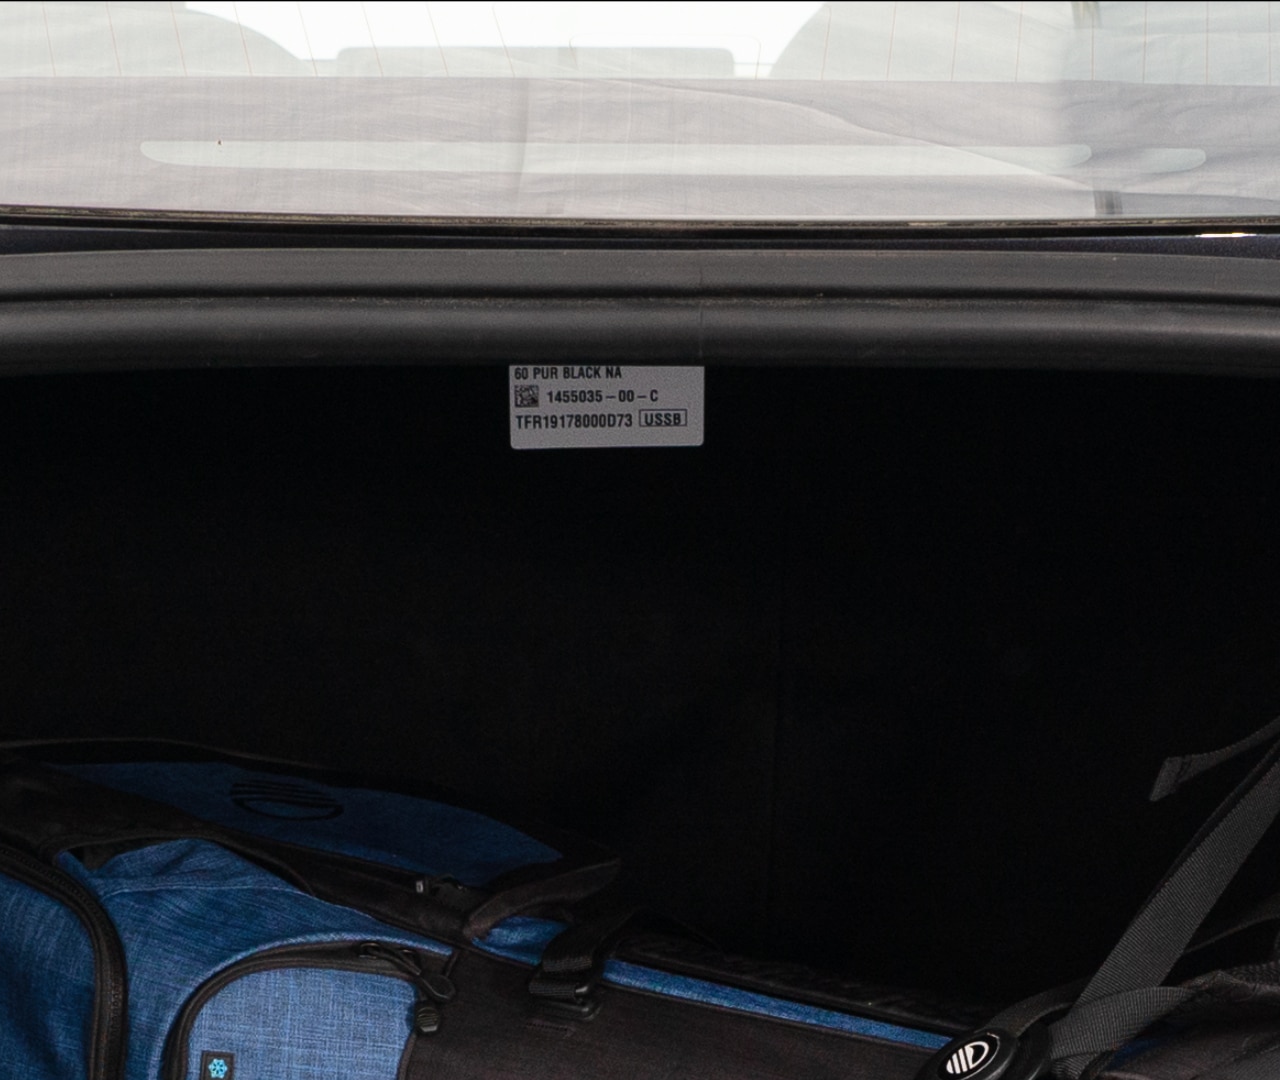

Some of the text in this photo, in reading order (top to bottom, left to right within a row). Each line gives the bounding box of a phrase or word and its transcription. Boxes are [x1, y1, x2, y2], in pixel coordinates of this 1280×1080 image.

[514, 366, 622, 380] 60 PUR BLACK NA
[644, 413, 681, 427] USSB
